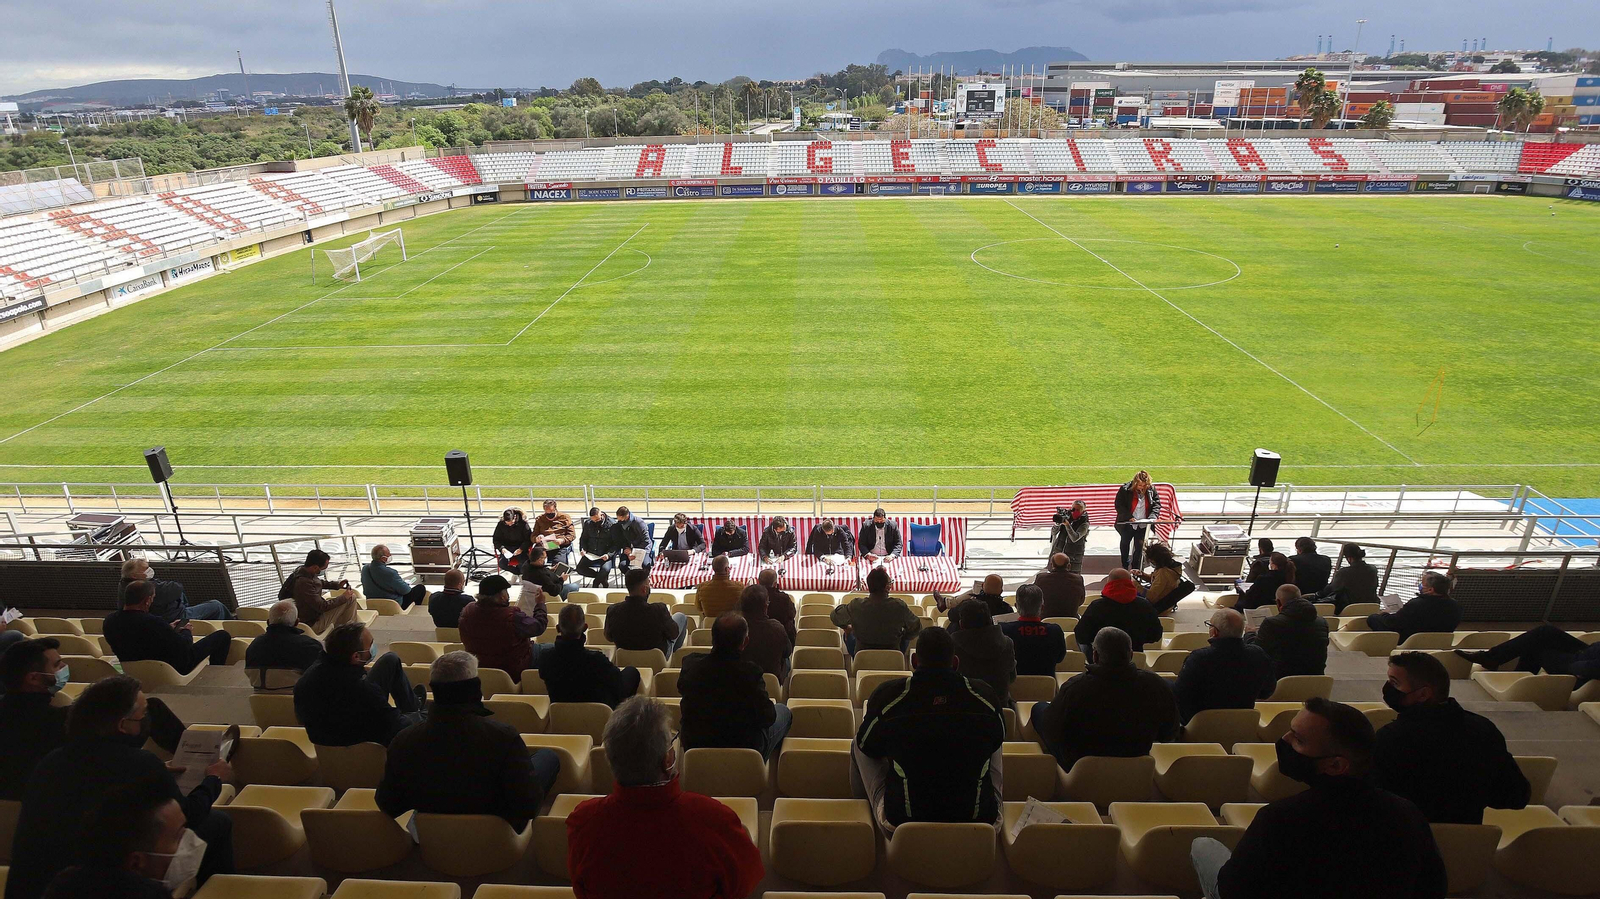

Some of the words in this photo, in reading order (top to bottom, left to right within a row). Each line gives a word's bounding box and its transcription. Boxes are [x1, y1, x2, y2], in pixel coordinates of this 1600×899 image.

[534, 189, 567, 199] NACEX
[126, 277, 158, 294] CaixaBank
[1018, 625, 1048, 636] 1912
